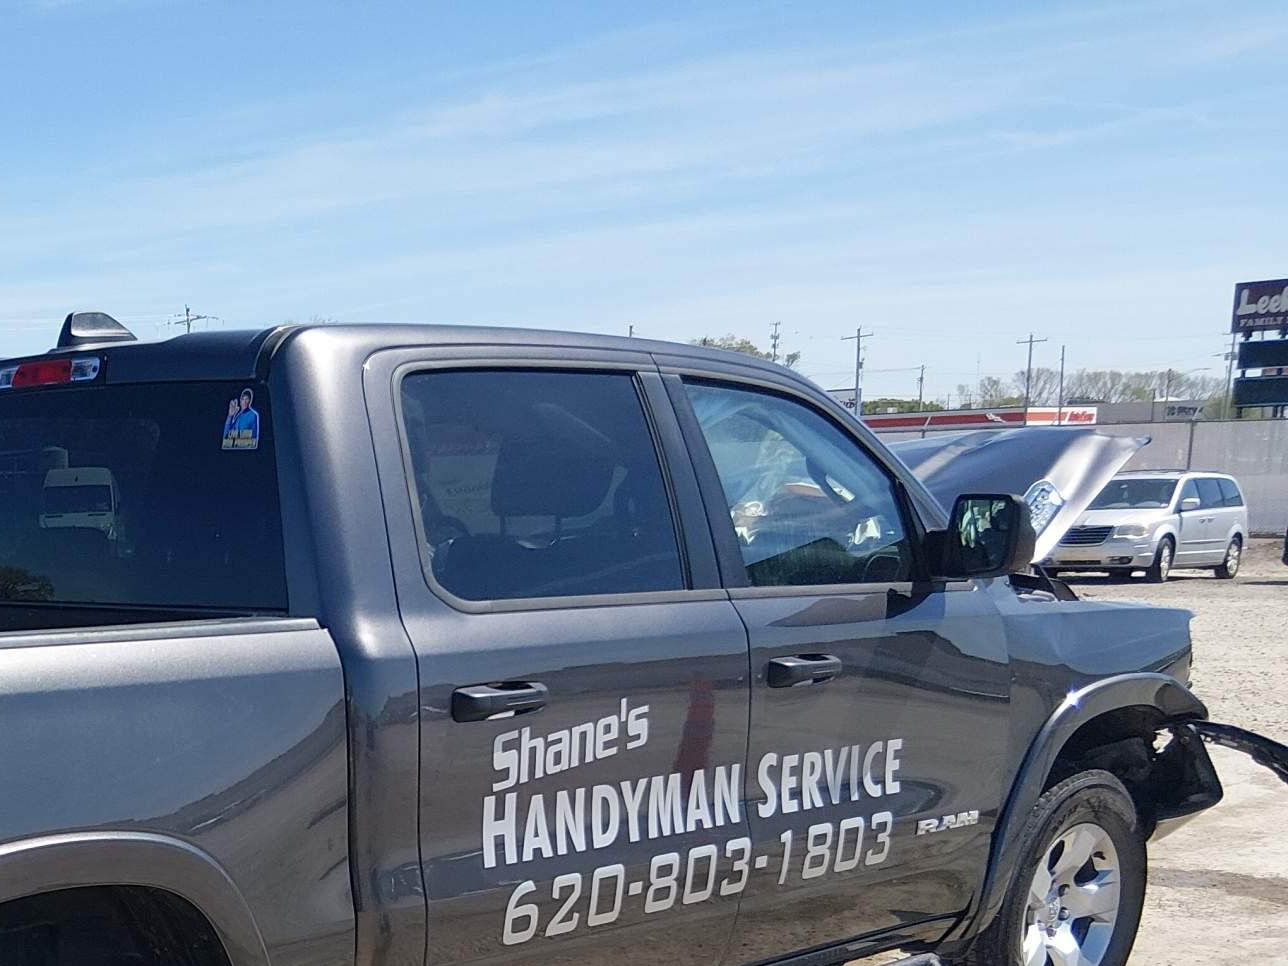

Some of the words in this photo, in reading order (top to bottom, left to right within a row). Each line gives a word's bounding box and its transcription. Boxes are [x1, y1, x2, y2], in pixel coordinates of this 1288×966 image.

[492, 697, 650, 793] Shane's
[481, 763, 742, 869] HANDYMAN
[757, 738, 904, 818] SERVICE
[915, 809, 980, 836] RAM
[502, 810, 894, 946] 620-803-1803
